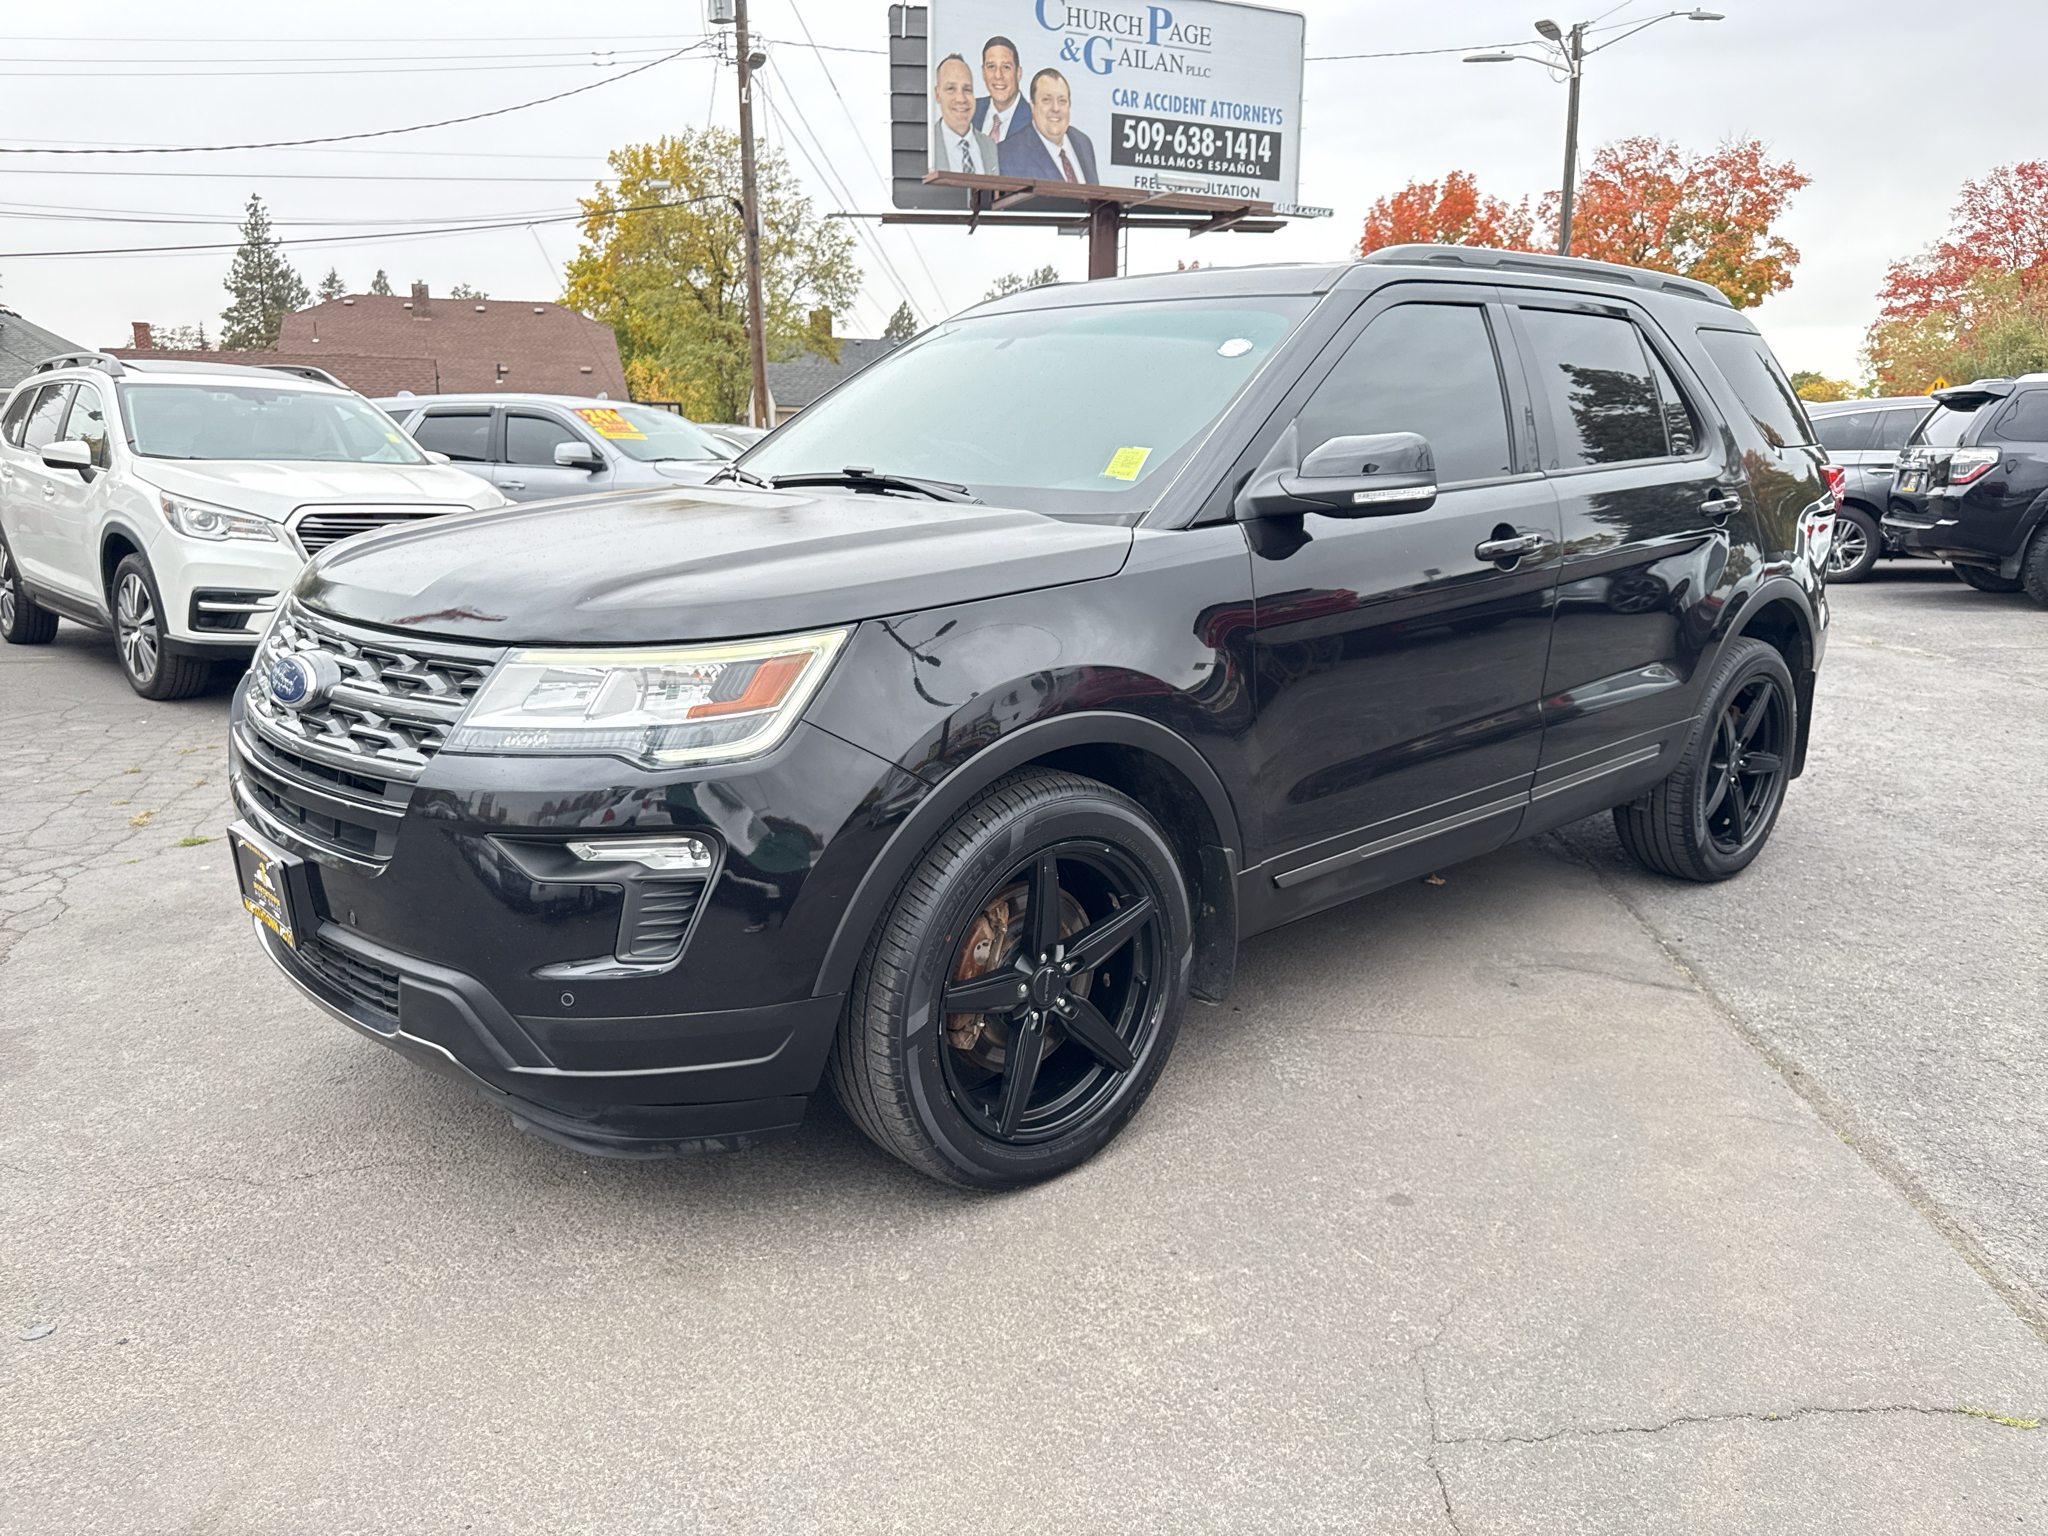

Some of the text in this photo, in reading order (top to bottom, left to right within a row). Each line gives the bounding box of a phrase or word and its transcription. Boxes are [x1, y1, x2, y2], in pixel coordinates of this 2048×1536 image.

[1035, 0, 1212, 46] CHURCH PAGE
[1185, 65, 1212, 78] PLLC
[1112, 88, 1283, 125] CAR ACCIDENT ATTORNEYS
[1122, 119, 1272, 163] 509-638-1414
[1134, 153, 1262, 175] HABLAMOS ESPAÑOL
[273, 661, 299, 695] Ford
